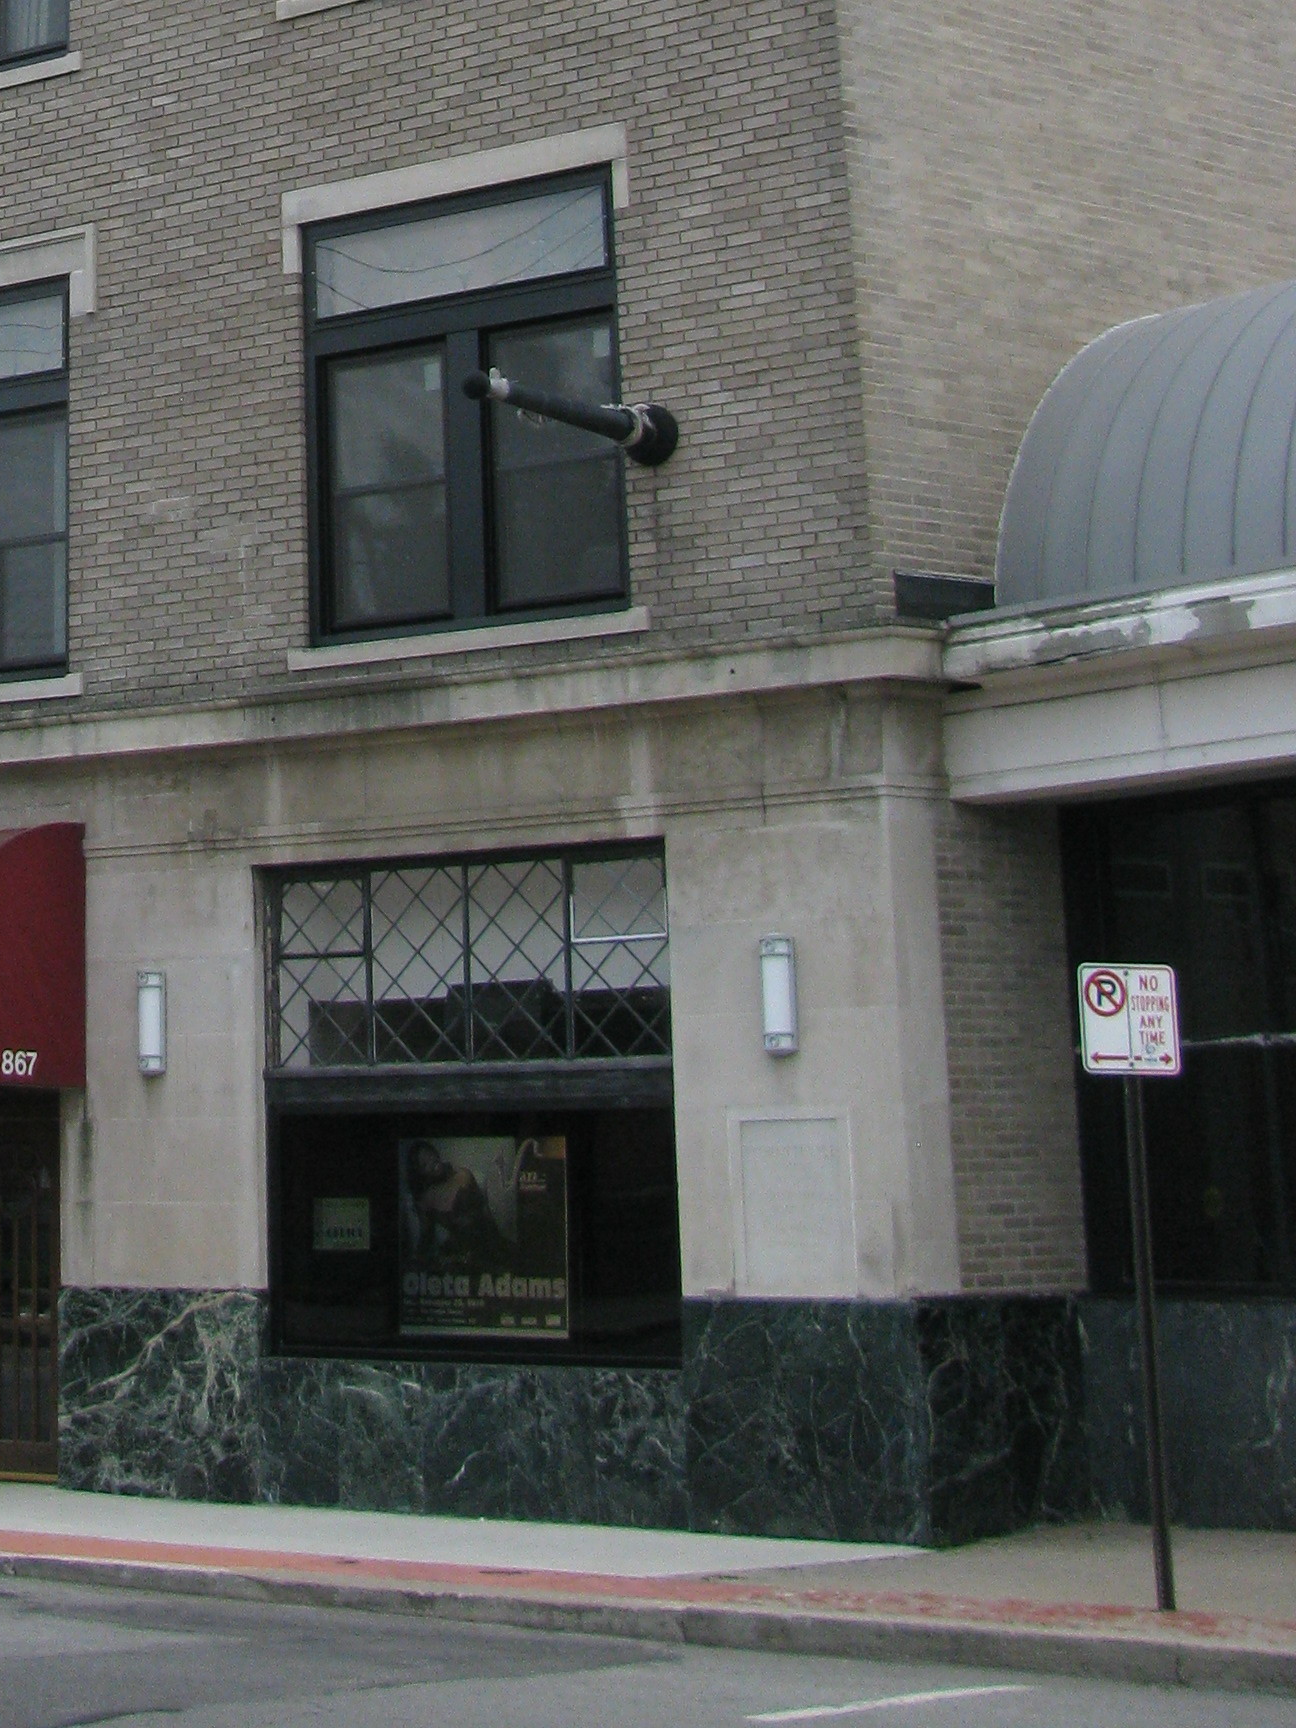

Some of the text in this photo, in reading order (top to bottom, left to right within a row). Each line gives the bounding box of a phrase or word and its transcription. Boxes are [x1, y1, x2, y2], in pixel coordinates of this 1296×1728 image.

[1139, 975, 1158, 991] NO
[1131, 995, 1169, 1012] STOPPING
[1140, 1015, 1162, 1028] ANY
[1139, 1031, 1165, 1044] TIME
[1, 1049, 39, 1076] 867
[477, 1272, 567, 1300] Adams
